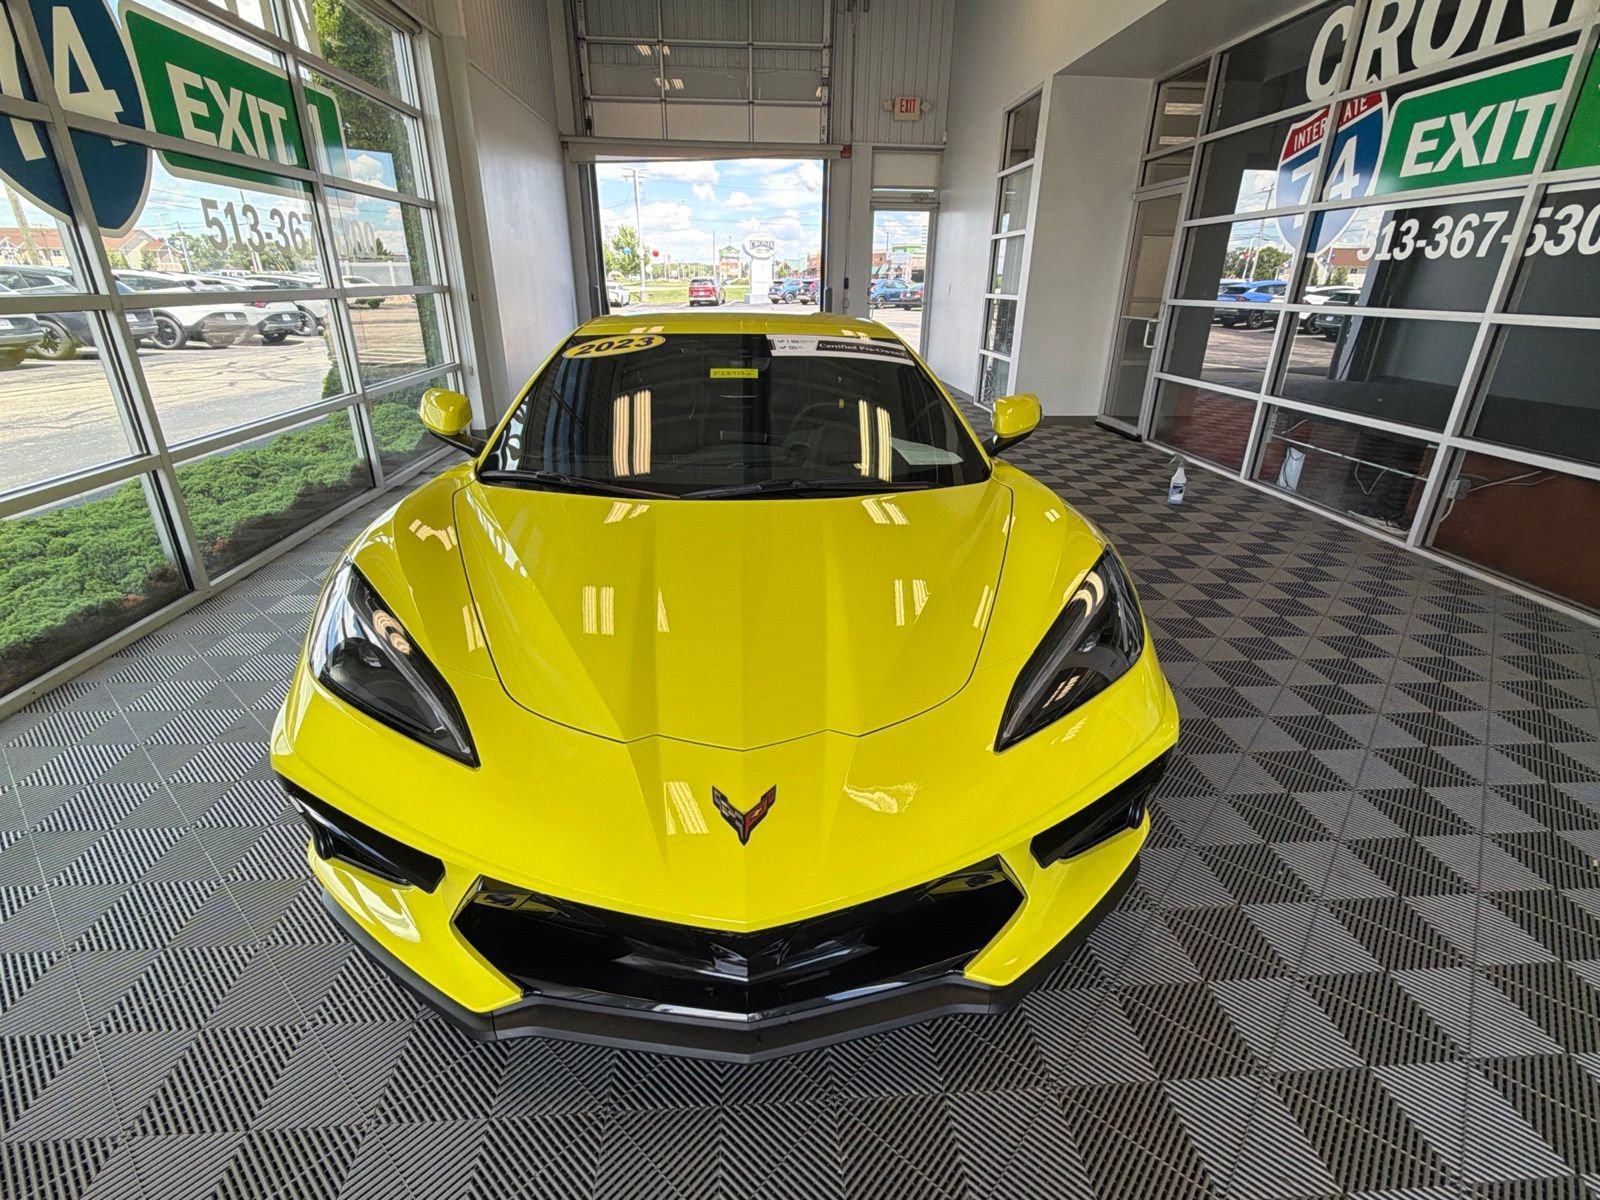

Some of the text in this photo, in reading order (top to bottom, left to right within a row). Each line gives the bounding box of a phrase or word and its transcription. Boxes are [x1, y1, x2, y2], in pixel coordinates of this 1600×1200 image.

[164, 62, 298, 166] EXIT
[899, 98, 917, 113] EXIT
[1399, 89, 1560, 179] EXIT
[1291, 134, 1360, 229] 74
[573, 336, 655, 356] 2023
[818, 342, 859, 352] Certified
[859, 345, 905, 357] Pre-Owned
